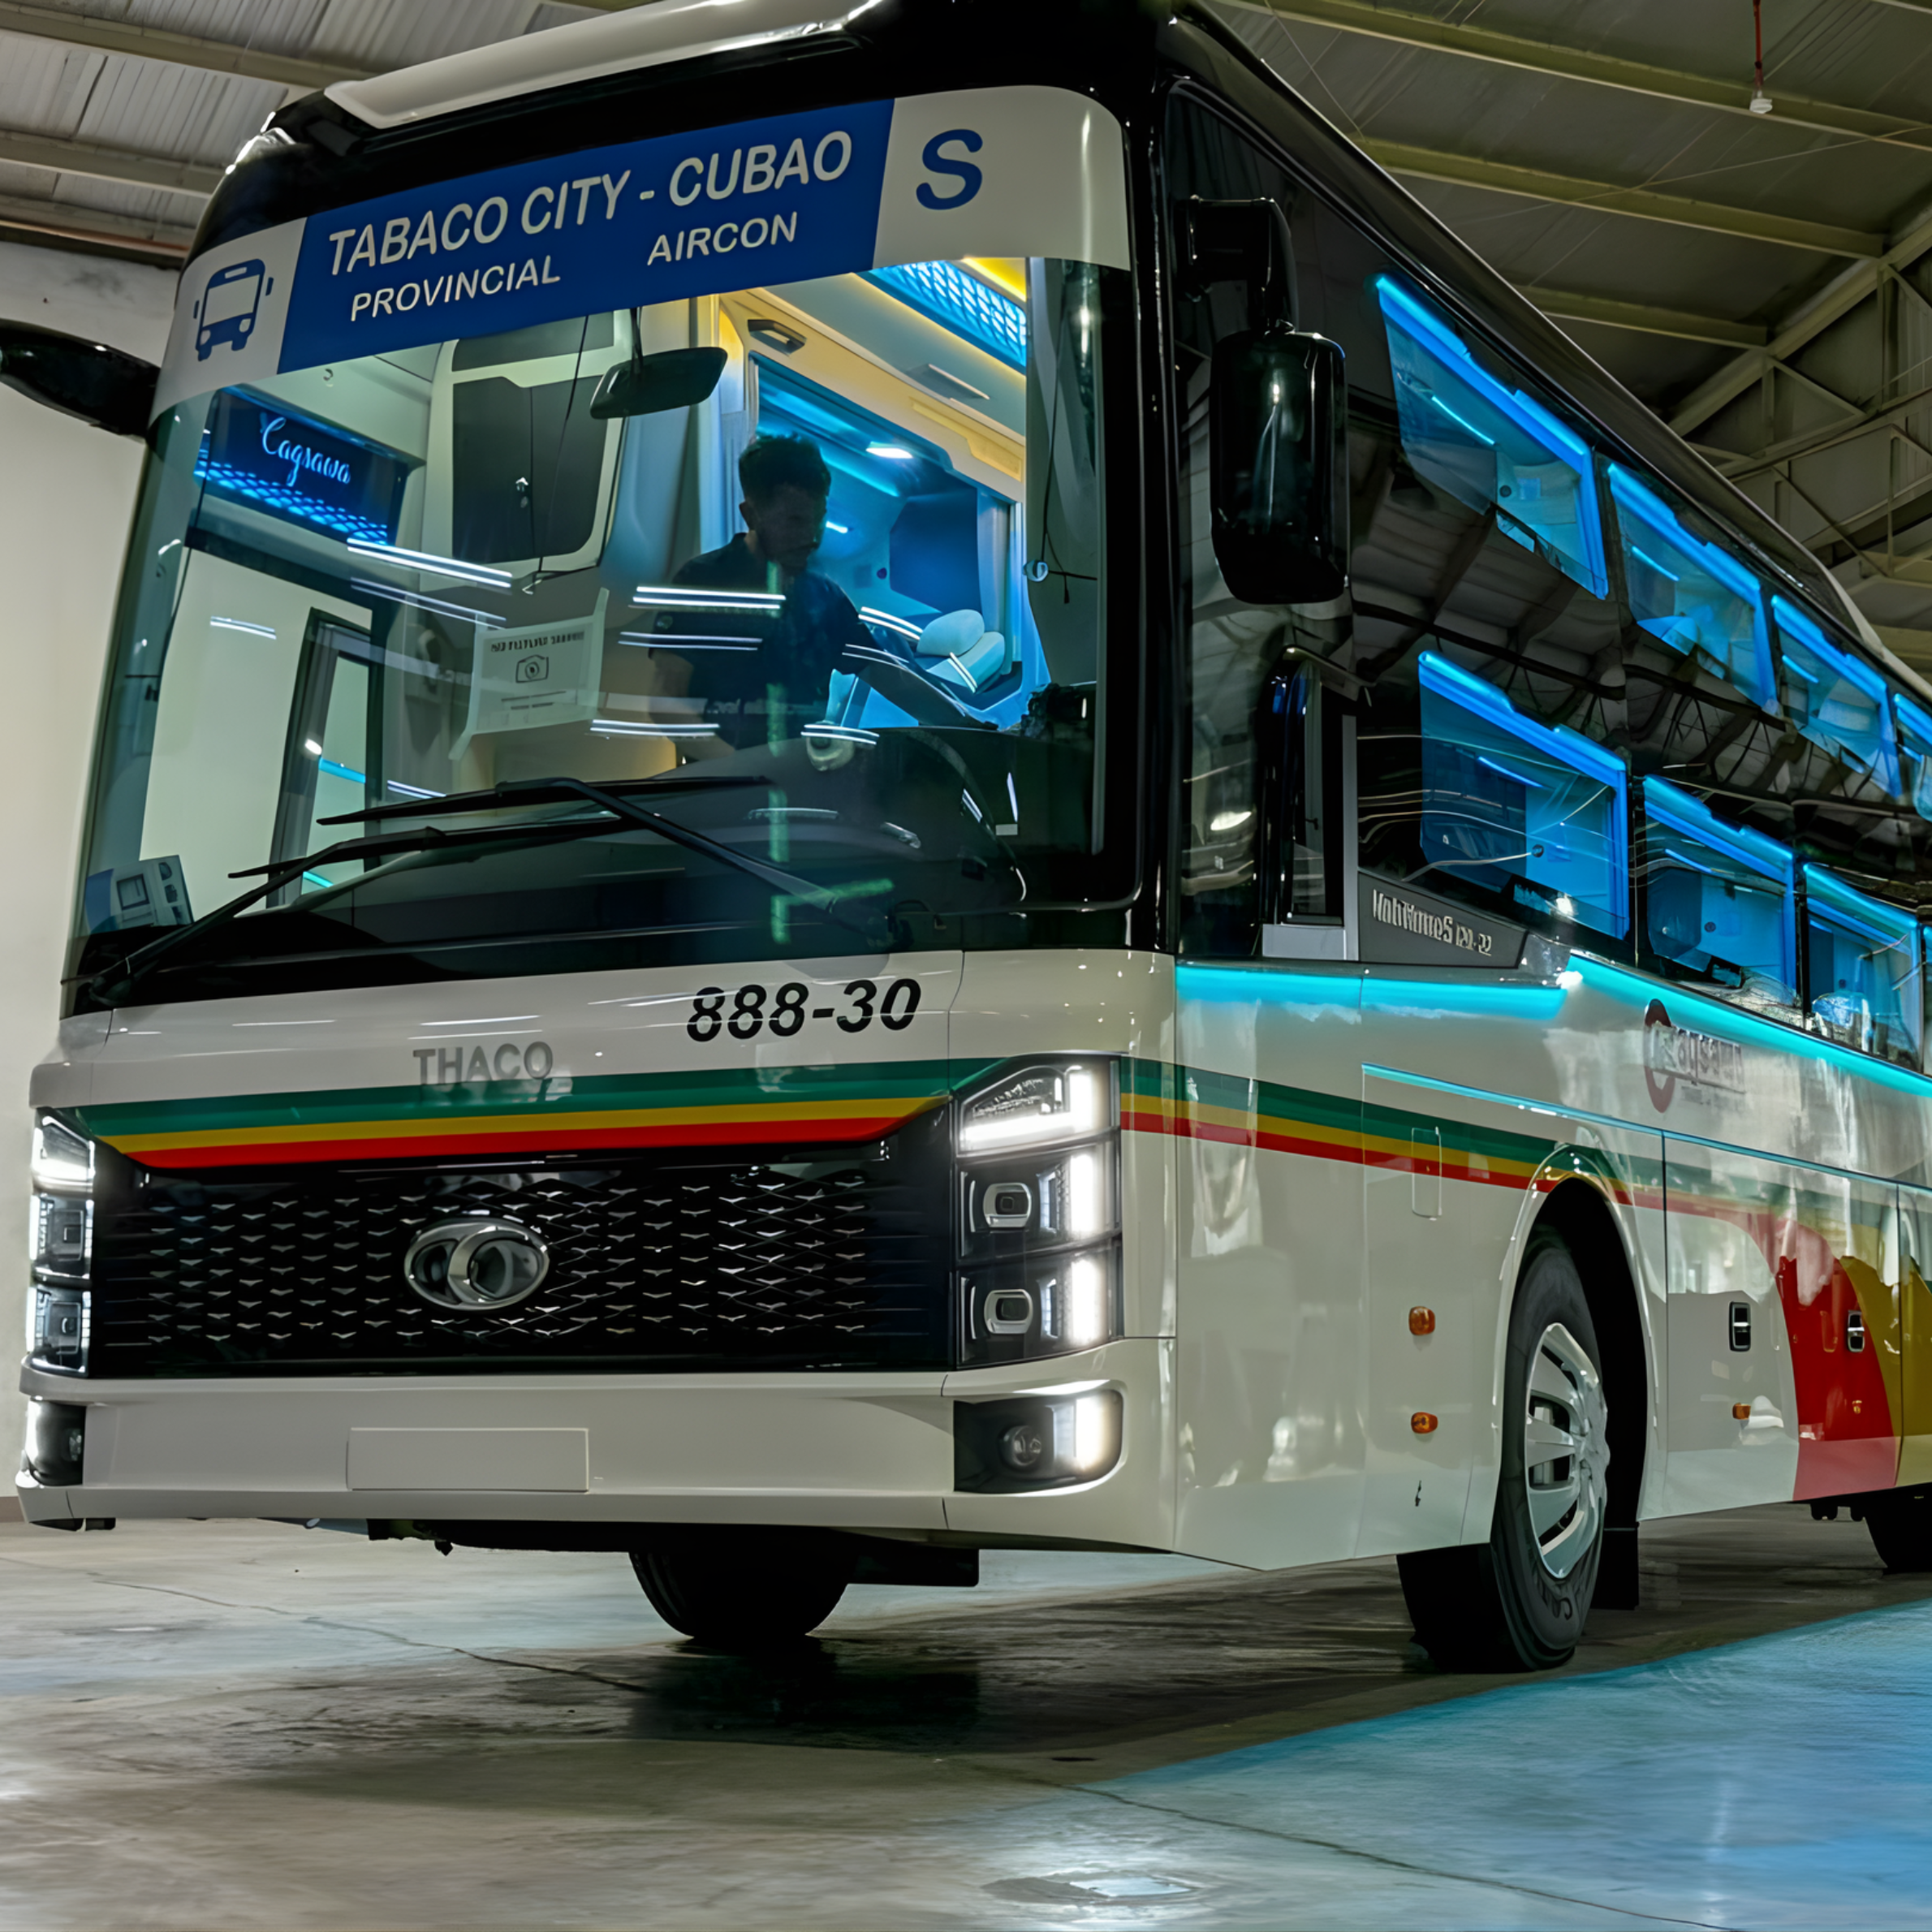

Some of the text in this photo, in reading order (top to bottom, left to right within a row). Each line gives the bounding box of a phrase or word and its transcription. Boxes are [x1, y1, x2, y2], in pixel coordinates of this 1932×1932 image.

[916, 128, 983, 210] S
[329, 131, 852, 276] TABACO CITY - CUBAO
[647, 211, 798, 266] AIRCON
[351, 255, 561, 322] PROVINCIAL
[686, 978, 921, 1042] 888-30
[412, 1041, 554, 1085] THACO
